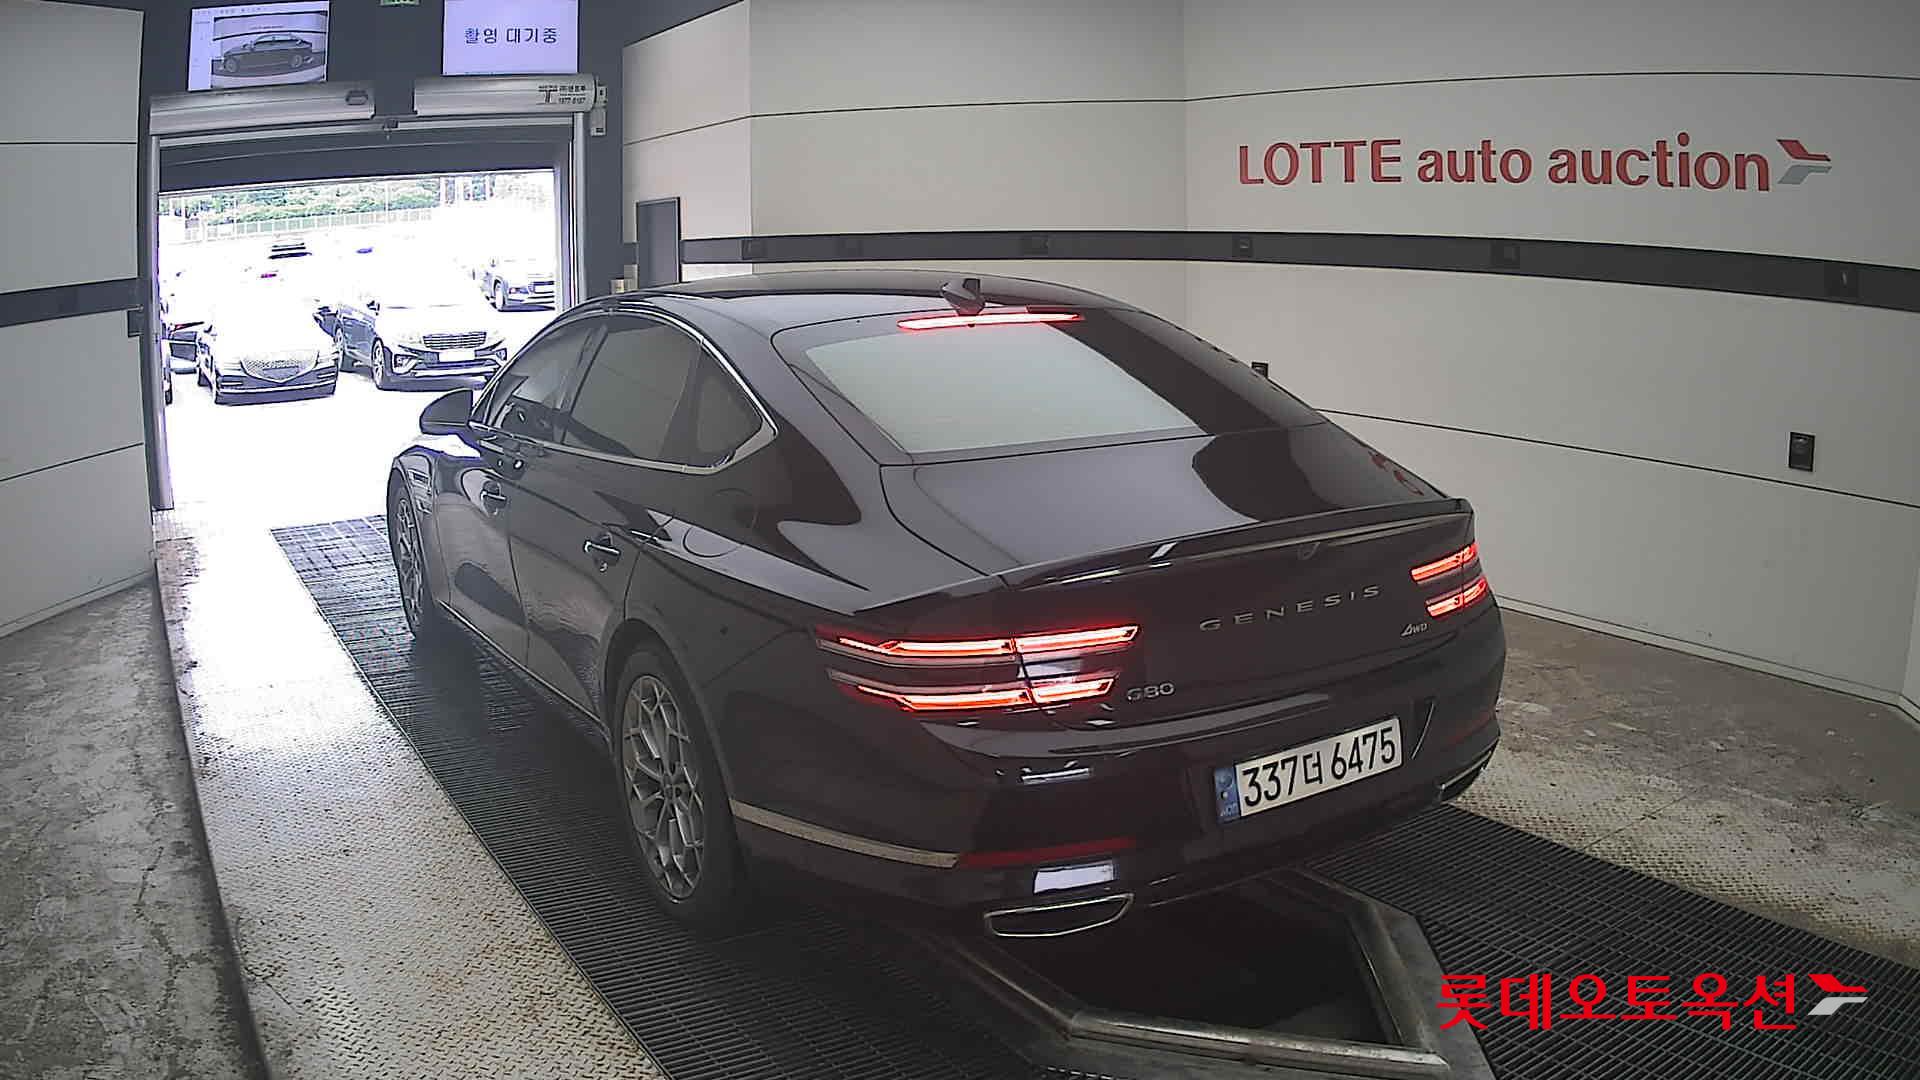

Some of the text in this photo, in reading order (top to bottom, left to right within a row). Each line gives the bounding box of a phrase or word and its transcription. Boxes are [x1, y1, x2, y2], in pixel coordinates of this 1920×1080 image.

[506, 27, 557, 44] 대기중
[1239, 132, 1770, 191] LOTTE auto auction
[1199, 585, 1381, 631] GENESIS
[1127, 682, 1175, 700] G80
[1241, 726, 1396, 808] 337더 6475
